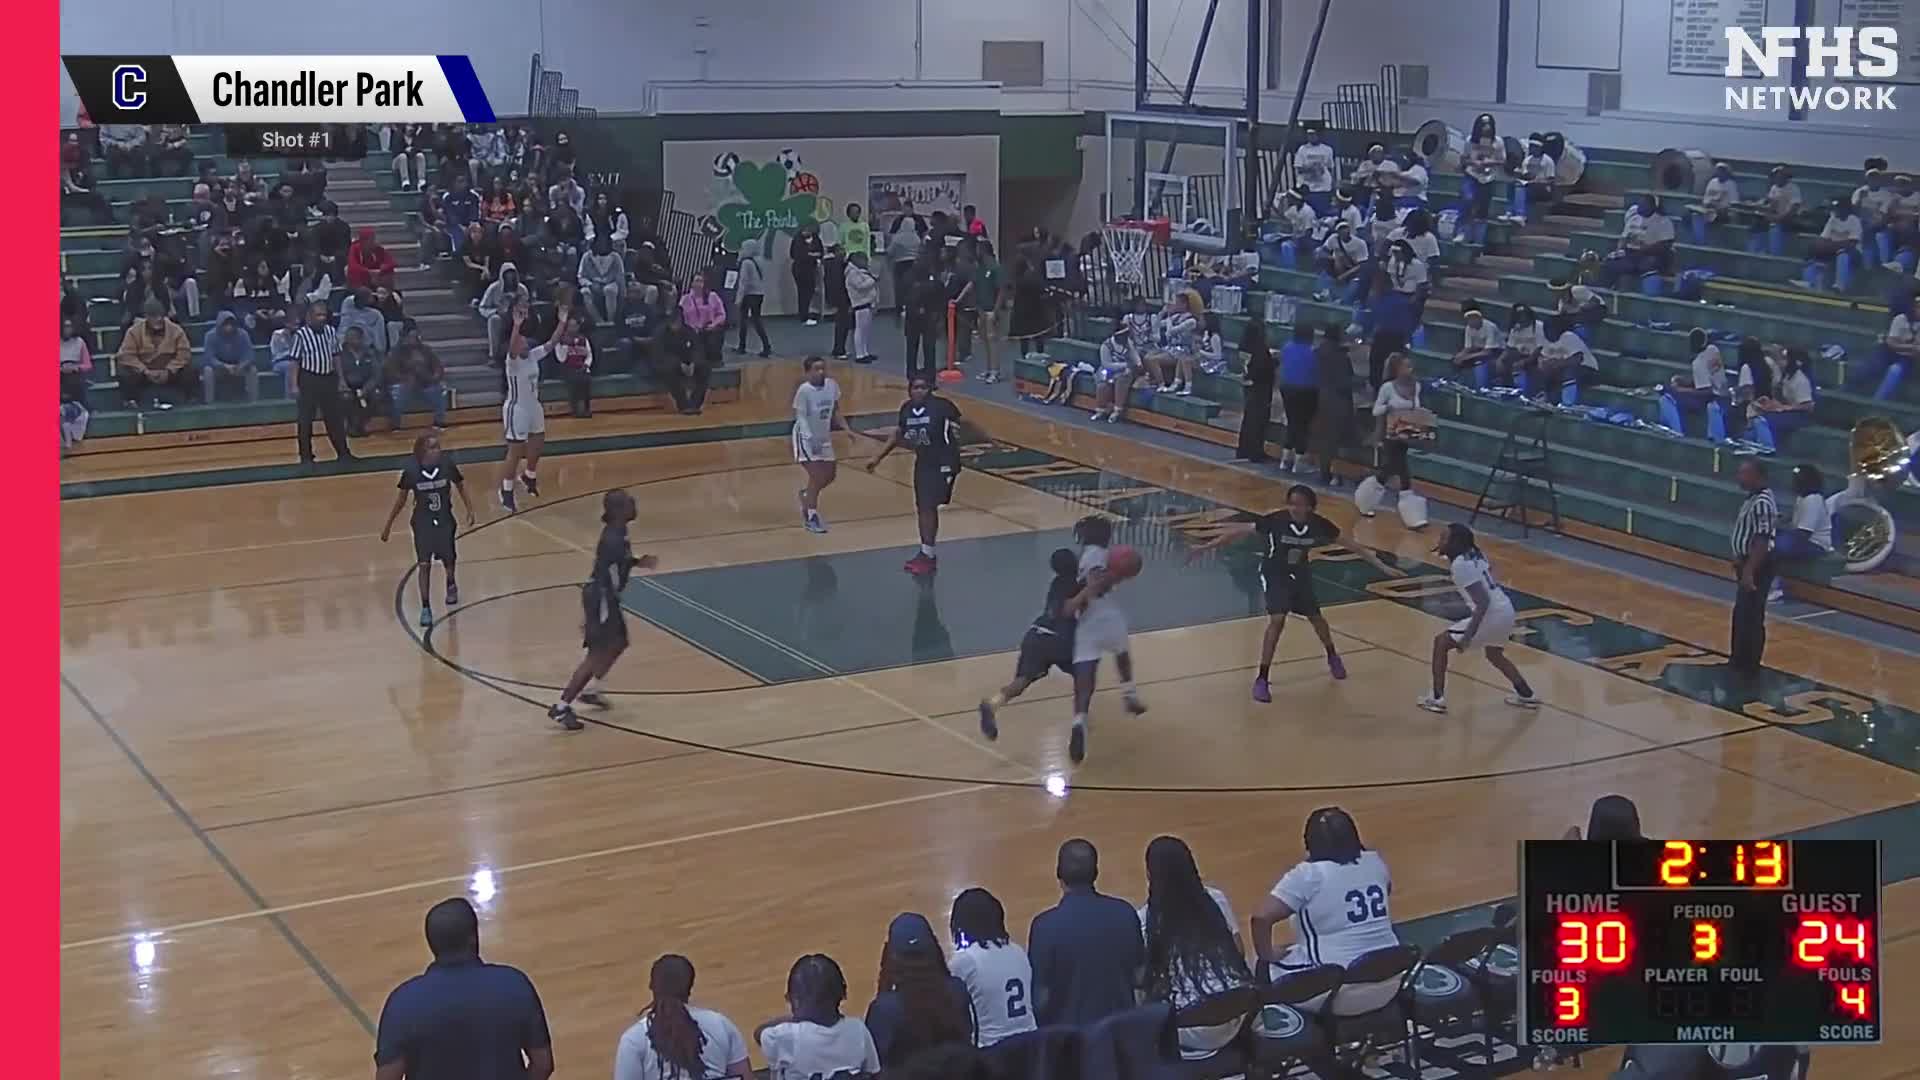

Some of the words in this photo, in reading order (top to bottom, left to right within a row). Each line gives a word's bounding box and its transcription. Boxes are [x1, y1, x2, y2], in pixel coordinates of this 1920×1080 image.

[428, 493, 441, 511] 3
[1660, 840, 1783, 885] 2:13
[1344, 884, 1387, 924] 32
[1546, 894, 1620, 913] HOME
[1673, 905, 1735, 919] PERIOD
[1782, 893, 1862, 913] GUEST
[1560, 920, 1628, 964] 30
[1693, 924, 1719, 960] 3
[1797, 920, 1865, 963] 24
[1531, 969, 1587, 984] FOULS
[1645, 968, 1708, 983] PLAYER
[1720, 967, 1763, 982] FOUL
[1818, 967, 1872, 982] FOULS
[1005, 977, 1028, 1019] 2
[1558, 987, 1580, 1020] 3
[1841, 987, 1865, 1015] 4
[1532, 1028, 1589, 1042] SCORE
[1677, 1026, 1735, 1040] MATCH
[1819, 1025, 1874, 1040] SCORE
